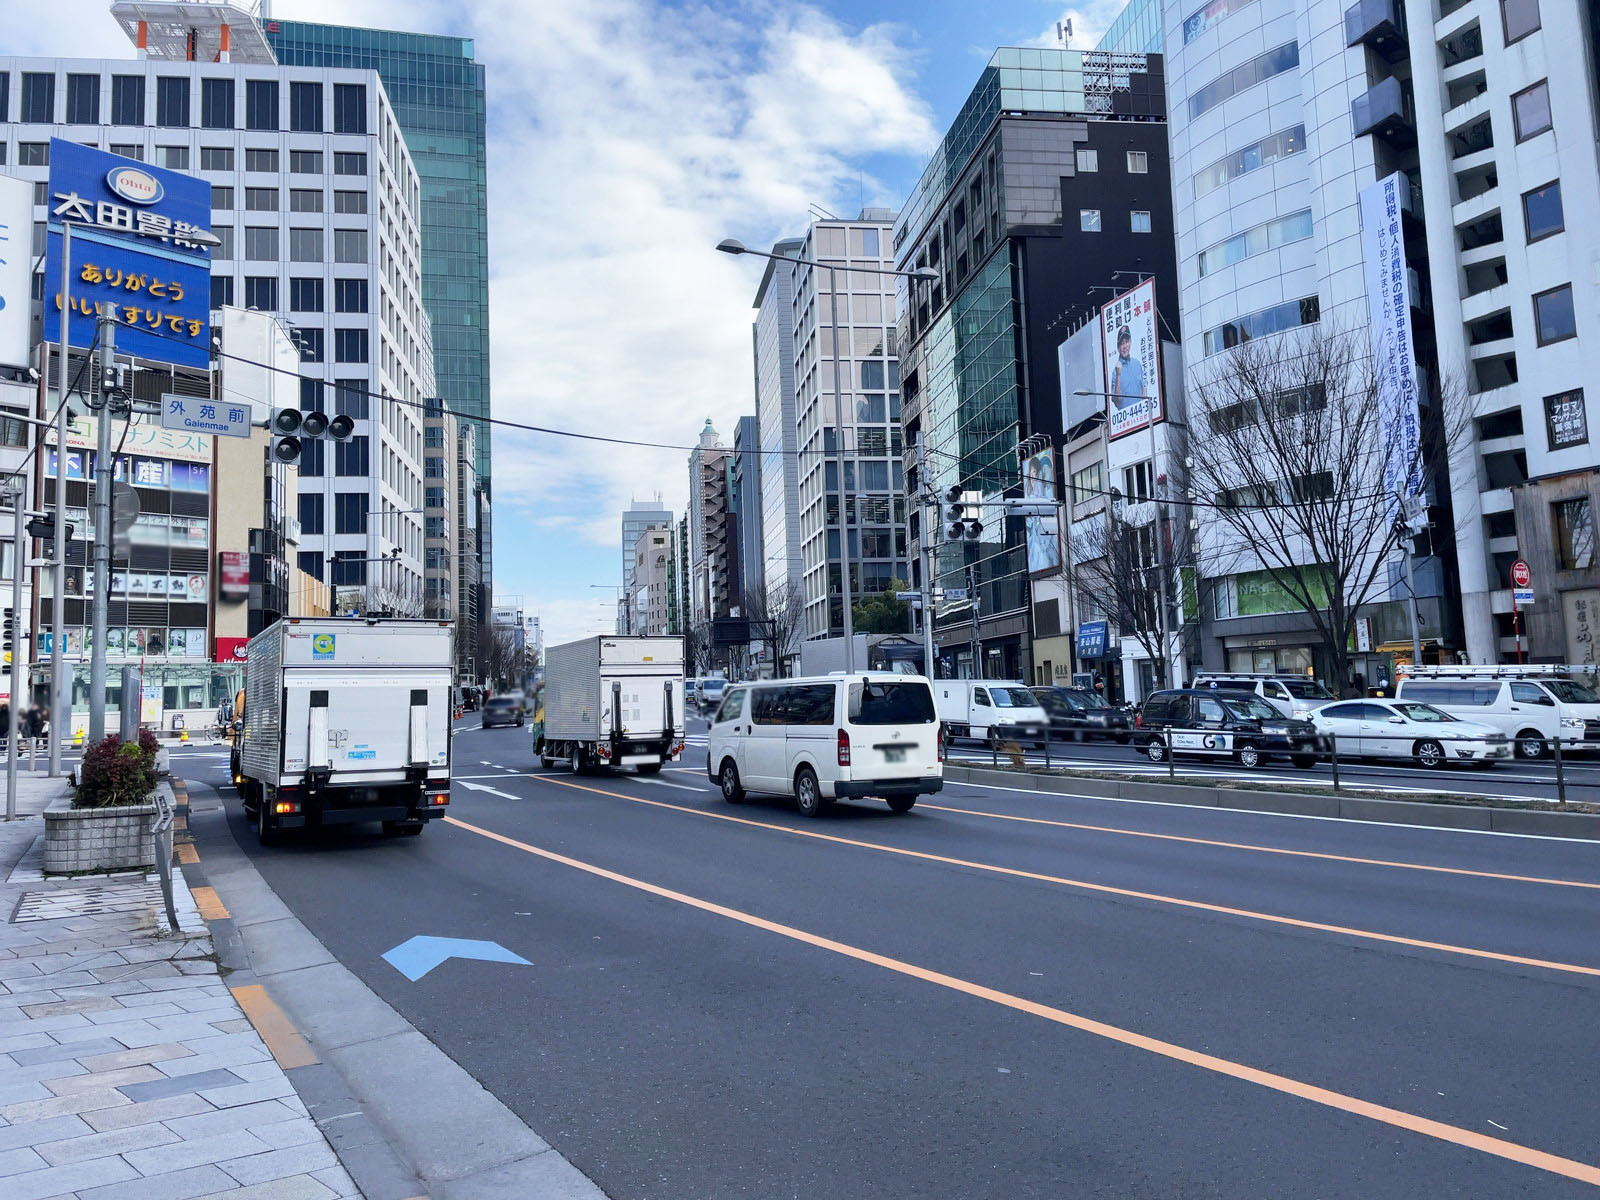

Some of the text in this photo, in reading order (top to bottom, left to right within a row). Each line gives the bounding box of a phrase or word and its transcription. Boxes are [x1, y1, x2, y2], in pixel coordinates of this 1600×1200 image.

[120, 177, 152, 193] Ohta
[53, 191, 208, 251] 太田胃散
[81, 263, 185, 301] ありがとう
[55, 292, 206, 337] いいすりです
[170, 400, 244, 424] 外苑前
[1551, 408, 1582, 423] マッサージ
[1554, 401, 1577, 414] アロマ
[184, 418, 229, 431] Gaienmae
[51, 438, 85, 446] CONA
[52, 450, 163, 484] 不産
